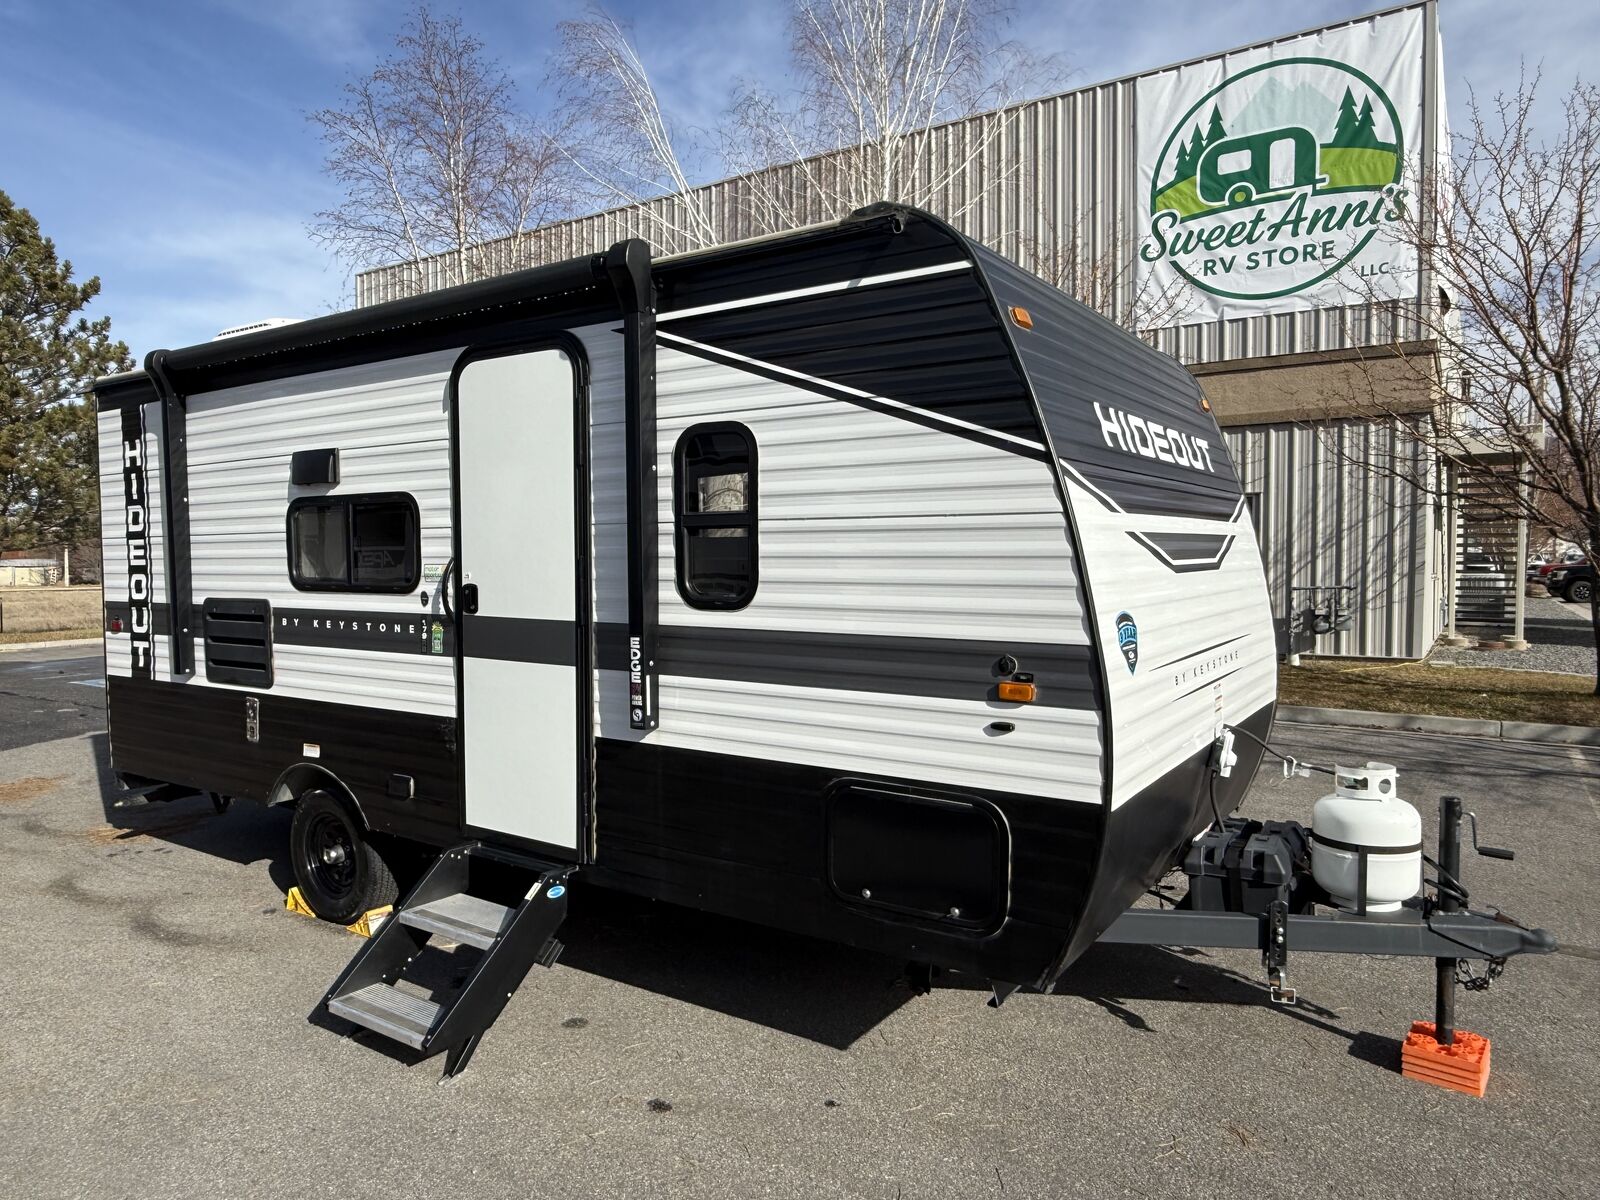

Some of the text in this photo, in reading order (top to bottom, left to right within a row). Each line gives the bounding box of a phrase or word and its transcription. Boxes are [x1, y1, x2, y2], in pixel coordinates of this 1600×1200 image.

[1140, 208, 1266, 262] Sweet
[1203, 240, 1335, 276] RV STORE
[1360, 262, 1389, 277] LLC
[1093, 401, 1215, 472] HIDEOUT
[124, 439, 149, 667] HIDEOUT
[282, 618, 415, 634] BY KEYSTONE
[630, 636, 642, 684] EDGE
[1174, 650, 1239, 686] BY KEYSTONE
